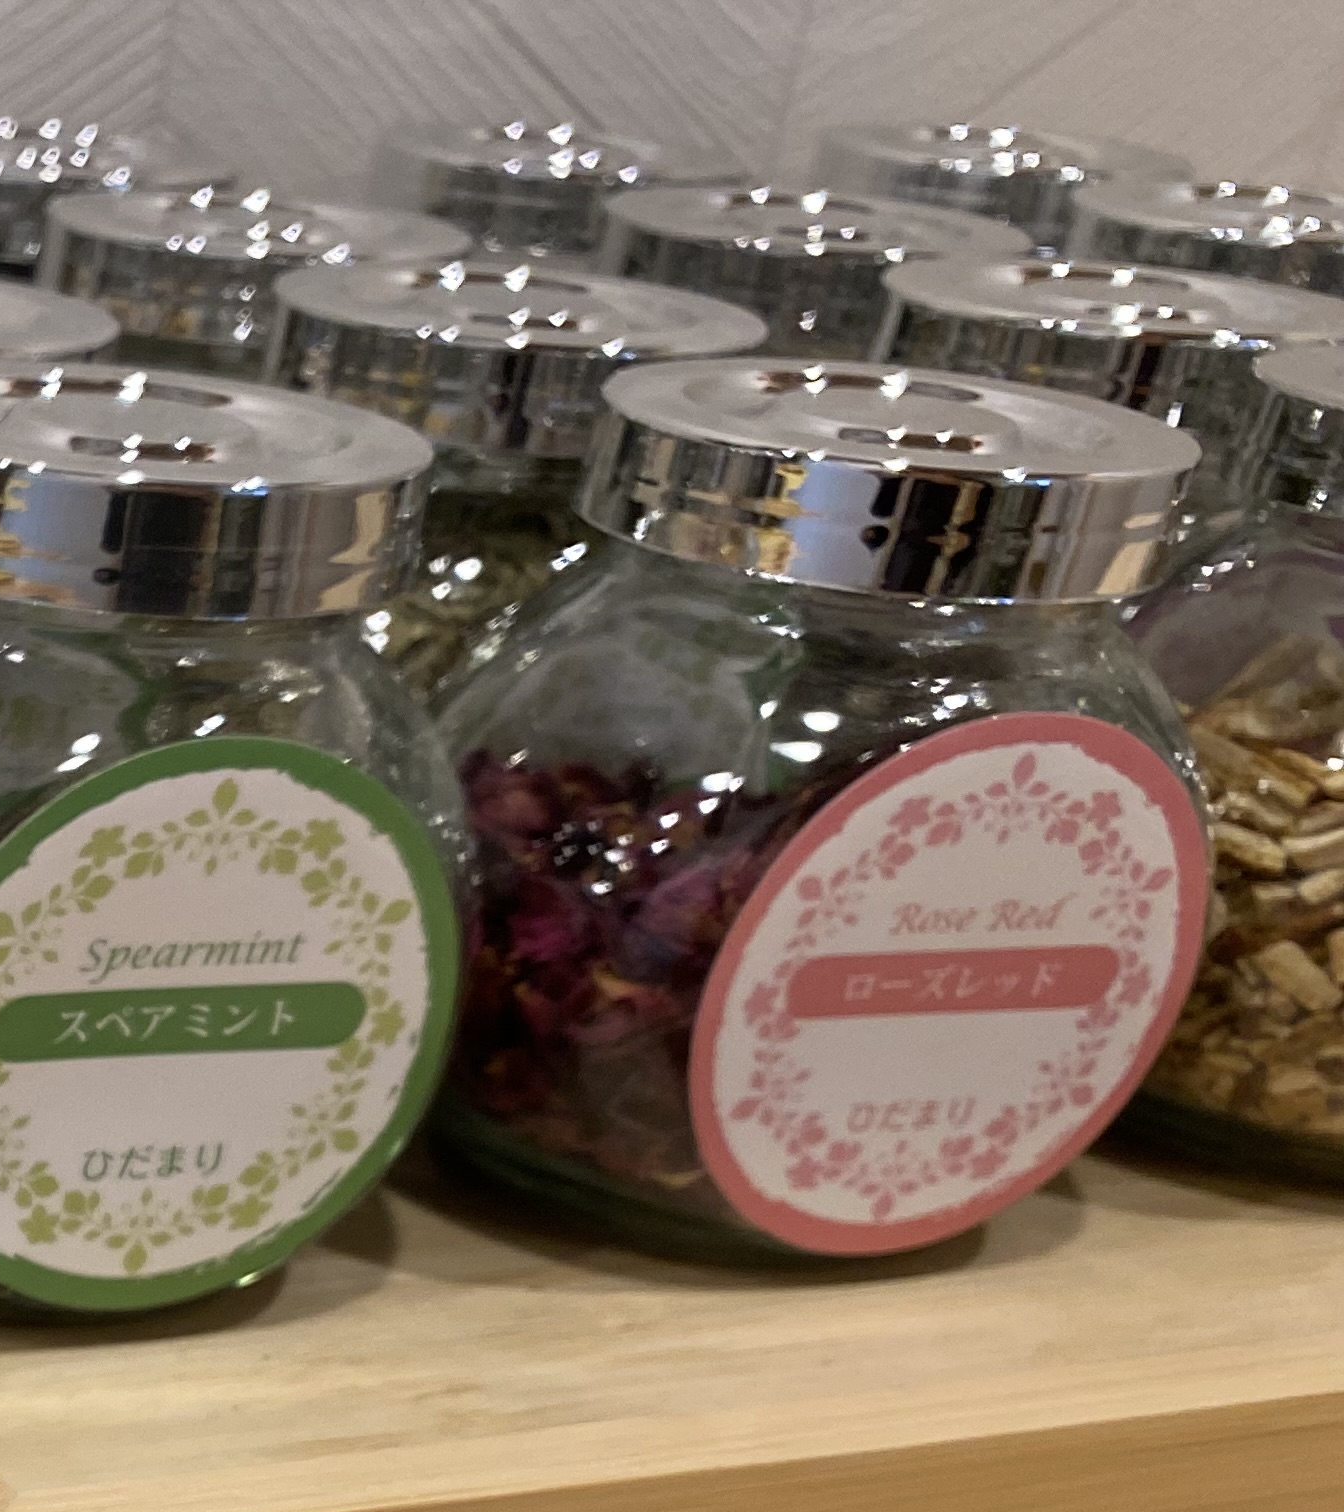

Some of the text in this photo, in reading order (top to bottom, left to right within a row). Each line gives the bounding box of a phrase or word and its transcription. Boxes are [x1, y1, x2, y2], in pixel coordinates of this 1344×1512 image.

[889, 892, 1077, 936] Rose Red
[78, 931, 305, 985] Spearmint
[844, 962, 1064, 1001] ローズレッド
[54, 1000, 297, 1044] スペアミント
[846, 1099, 978, 1134] ひだまり
[81, 1142, 224, 1182] ひだまり
